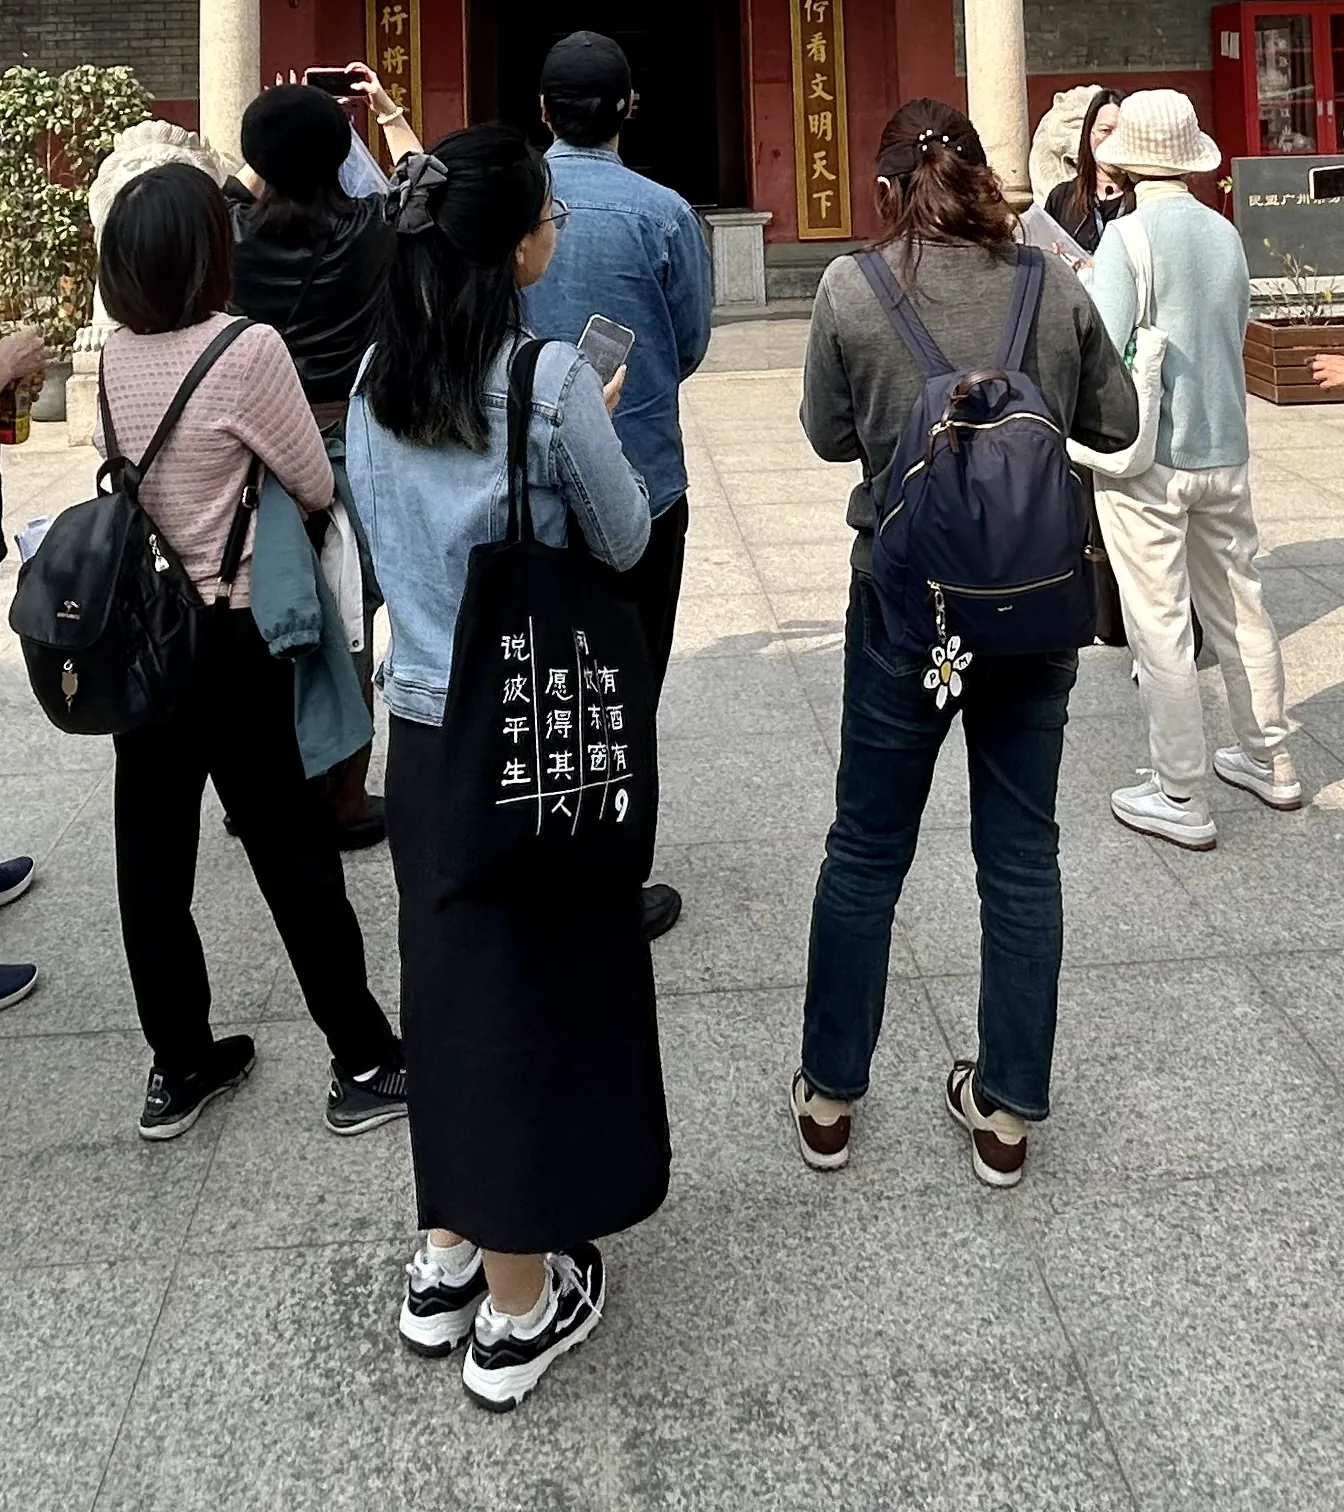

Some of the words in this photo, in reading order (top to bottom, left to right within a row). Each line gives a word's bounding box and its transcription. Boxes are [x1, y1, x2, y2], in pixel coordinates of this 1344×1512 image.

[500, 632, 531, 786] 说彼平生
[545, 668, 575, 817] 愿得其人
